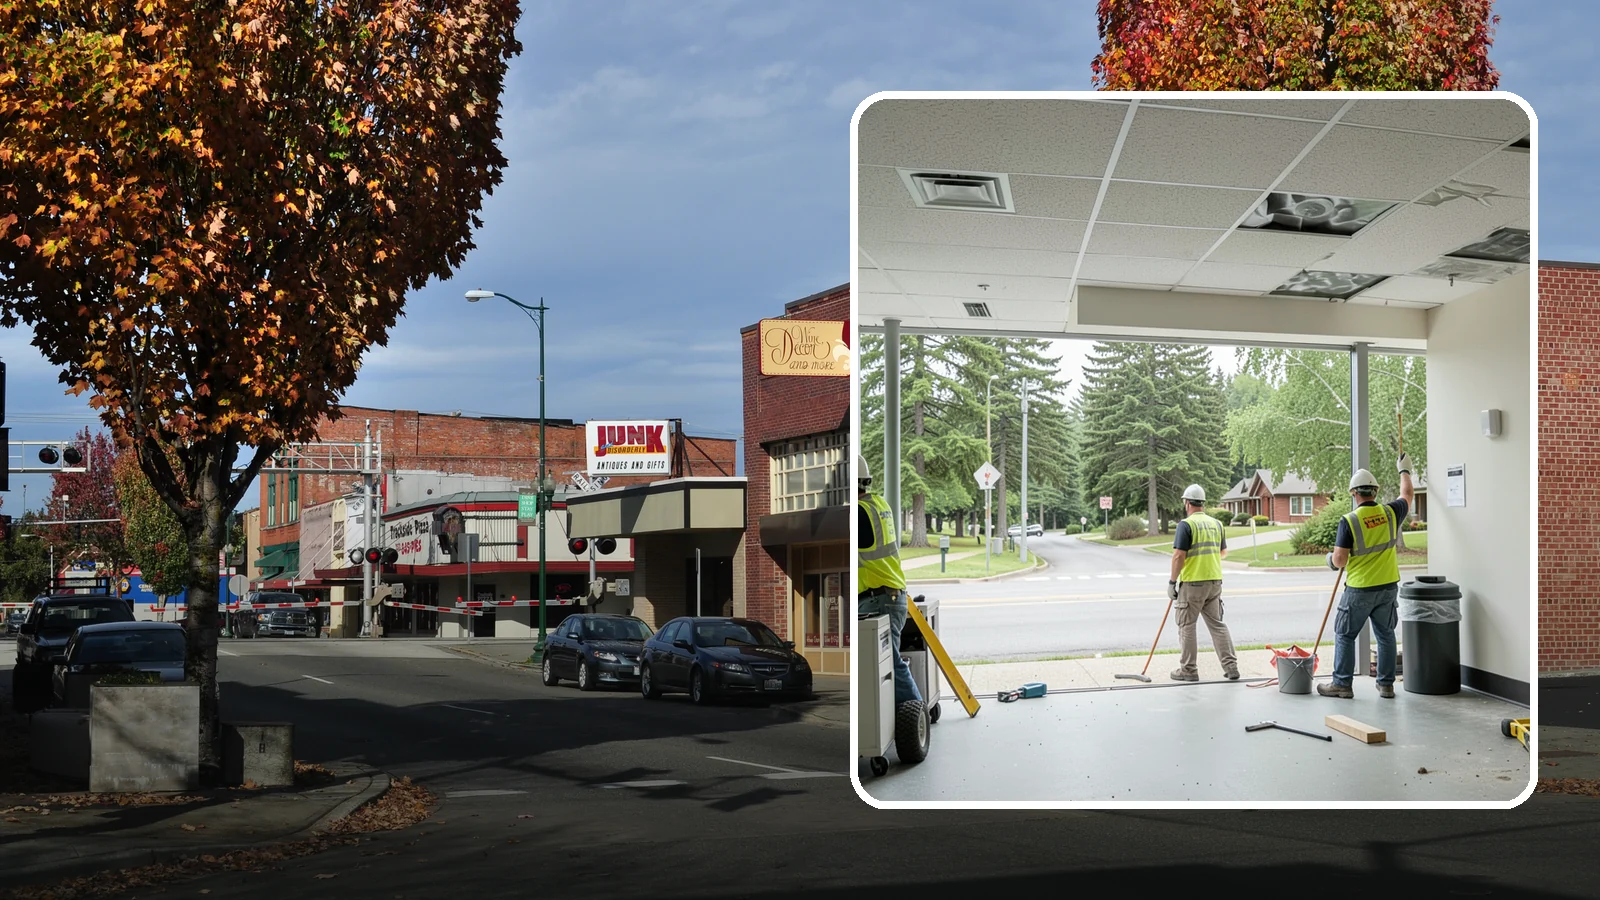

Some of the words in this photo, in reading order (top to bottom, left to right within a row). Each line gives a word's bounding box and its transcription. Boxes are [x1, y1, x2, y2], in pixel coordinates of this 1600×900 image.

[765, 327, 831, 365] Decor
[595, 425, 666, 457] JUNK
[597, 461, 628, 470] ANTIQUES
[631, 461, 644, 470] AND
[647, 460, 665, 470] GIFTS
[415, 519, 428, 534] Pizza
